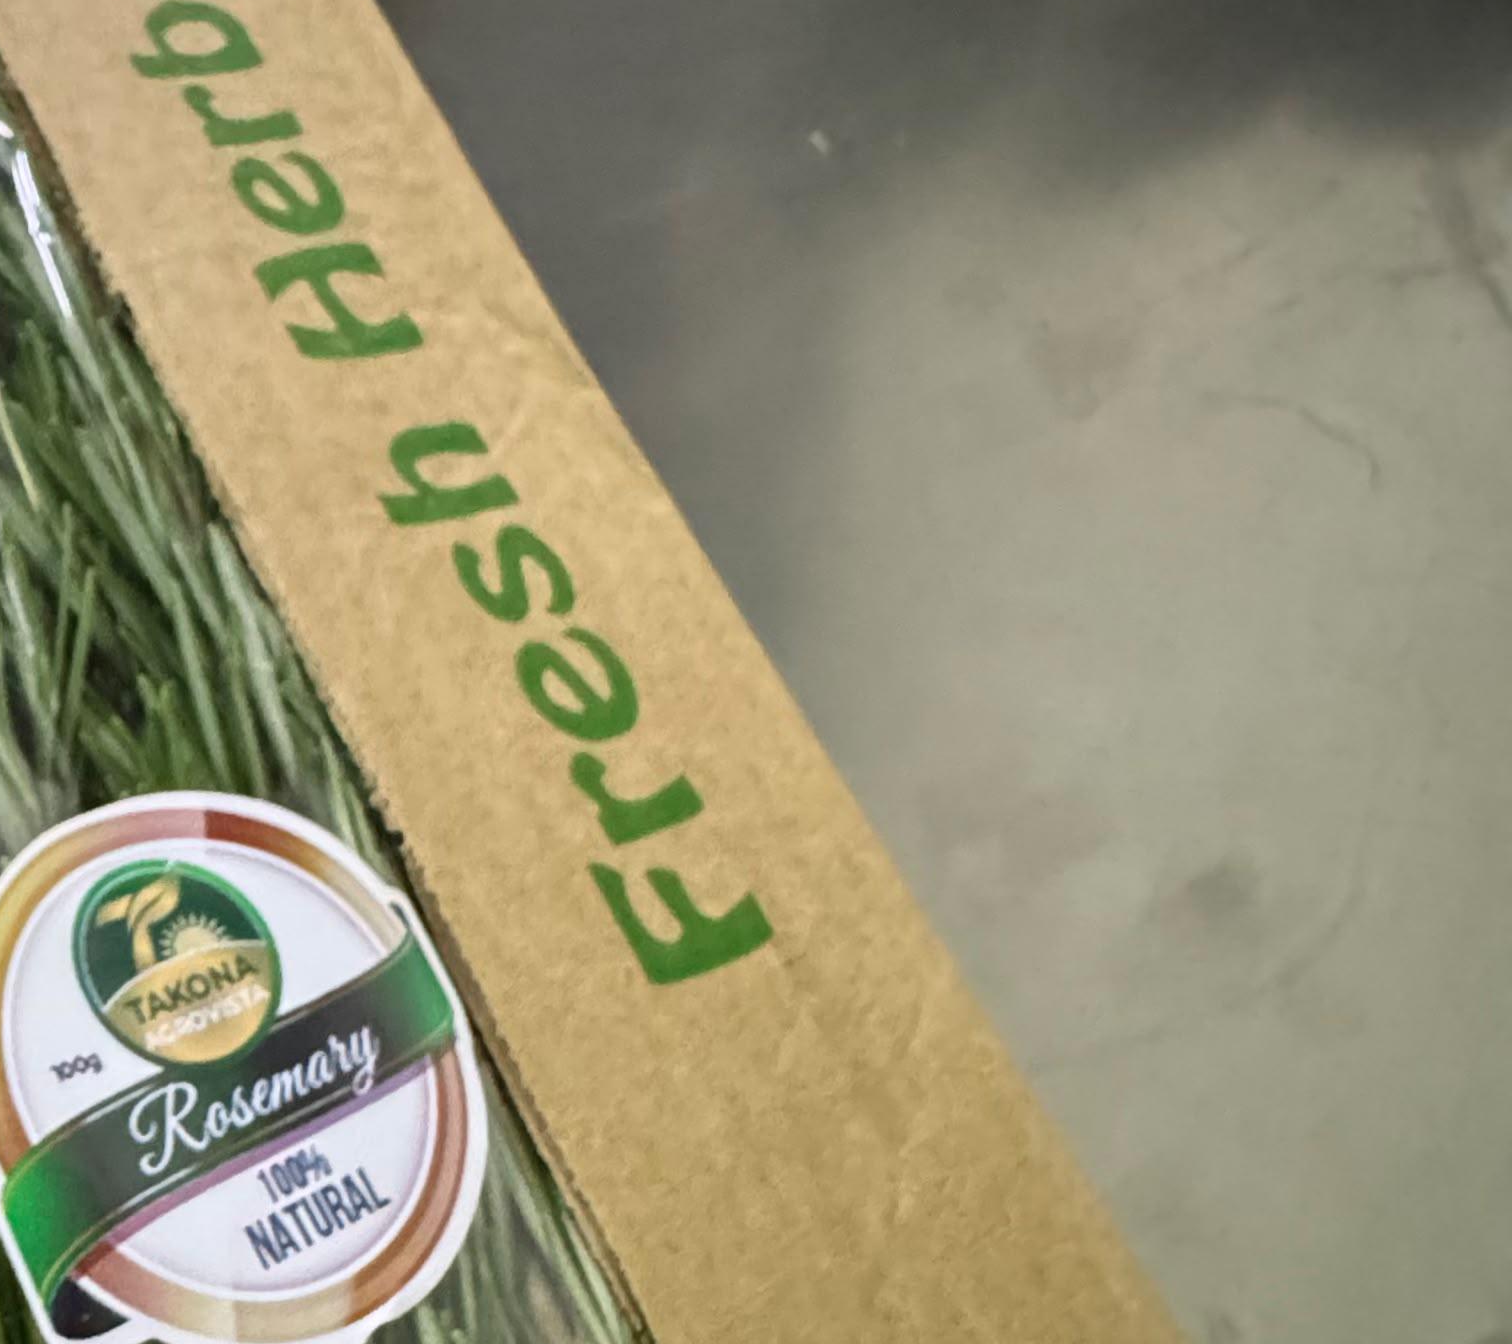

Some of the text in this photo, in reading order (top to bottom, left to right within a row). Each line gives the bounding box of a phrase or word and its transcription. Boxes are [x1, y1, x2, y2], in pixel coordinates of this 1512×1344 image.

[376, 420, 776, 986] Fresh
[127, 955, 260, 1026] TAKONA
[50, 1053, 104, 1084] 100g
[129, 1024, 380, 1177] Rosemary
[257, 1142, 334, 1205] 100%
[243, 1167, 393, 1272] NATURAL
